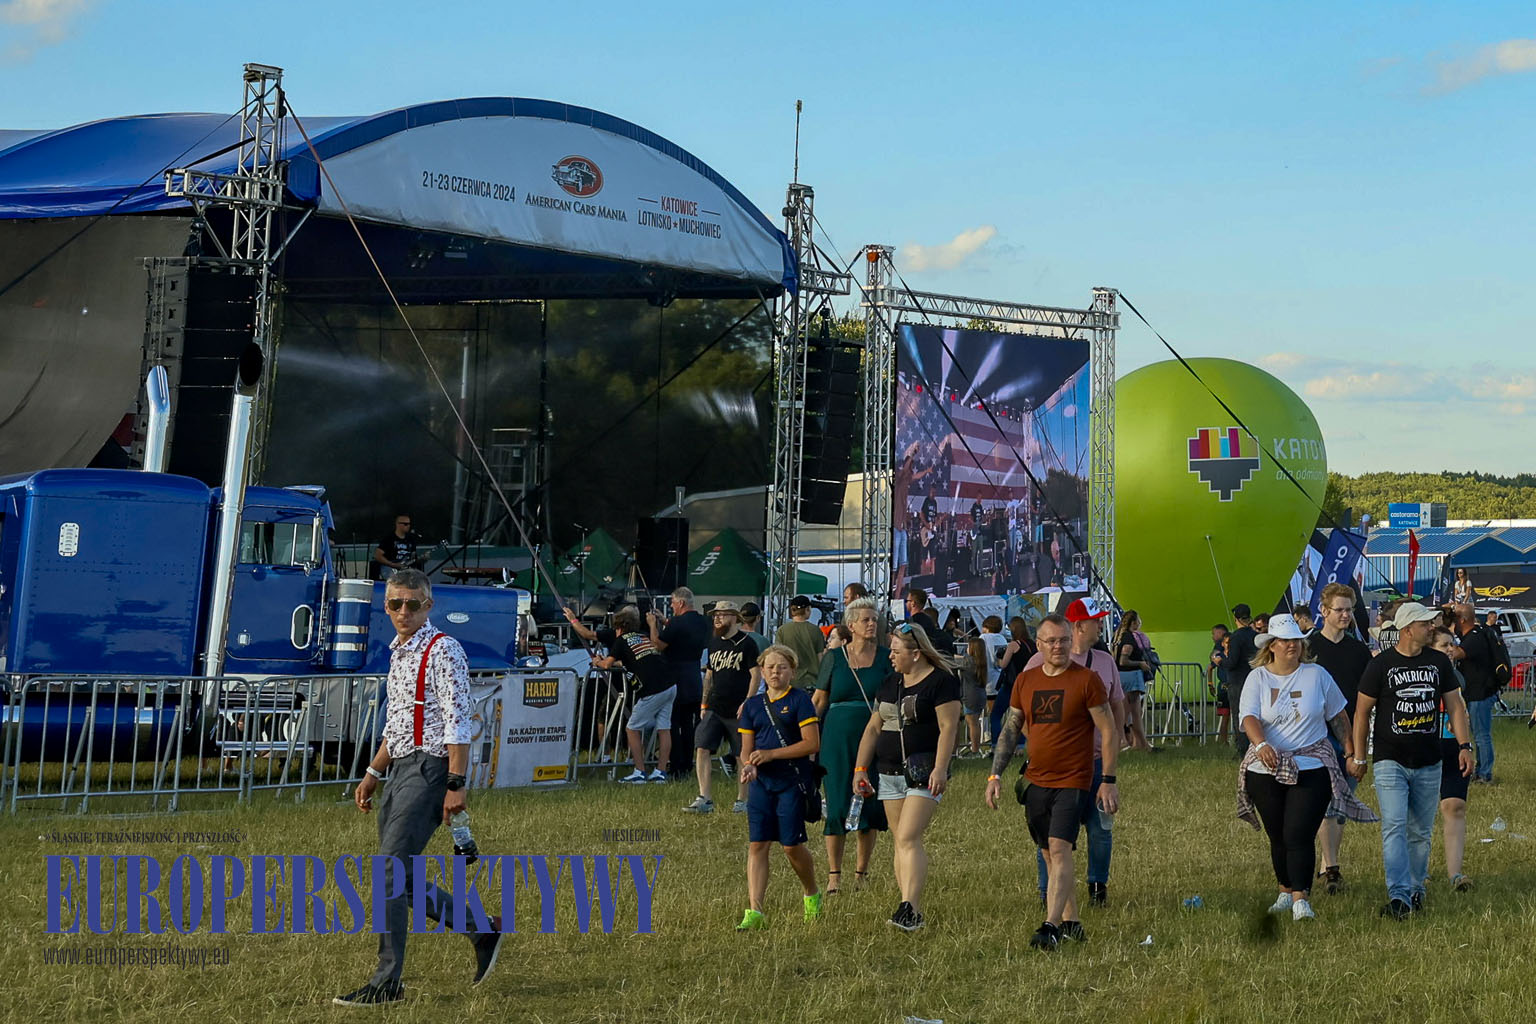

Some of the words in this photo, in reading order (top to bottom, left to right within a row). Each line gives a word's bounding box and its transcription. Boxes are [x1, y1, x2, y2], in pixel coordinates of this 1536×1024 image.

[422, 170, 449, 191] 21-23
[451, 175, 492, 198] CZERWCA
[493, 183, 516, 203] 2024
[525, 192, 572, 213] AMERICAN
[573, 201, 596, 215] CARS
[598, 205, 628, 222] MANIA
[661, 196, 698, 217] KATOWICE
[638, 209, 672, 231] LOTNISKO
[679, 217, 722, 239] MUCHOWIEC
[690, 551, 721, 575] LECH
[1394, 670, 1435, 686] AMERICAN
[525, 682, 558, 697] HARDY
[1396, 700, 1414, 713] CARS
[507, 736, 534, 744] BUDOWY
[538, 735, 567, 743] REMONTU
[509, 728, 518, 736] NA
[519, 726, 546, 735] KAŻDYM
[547, 726, 567, 734] ETAPIE
